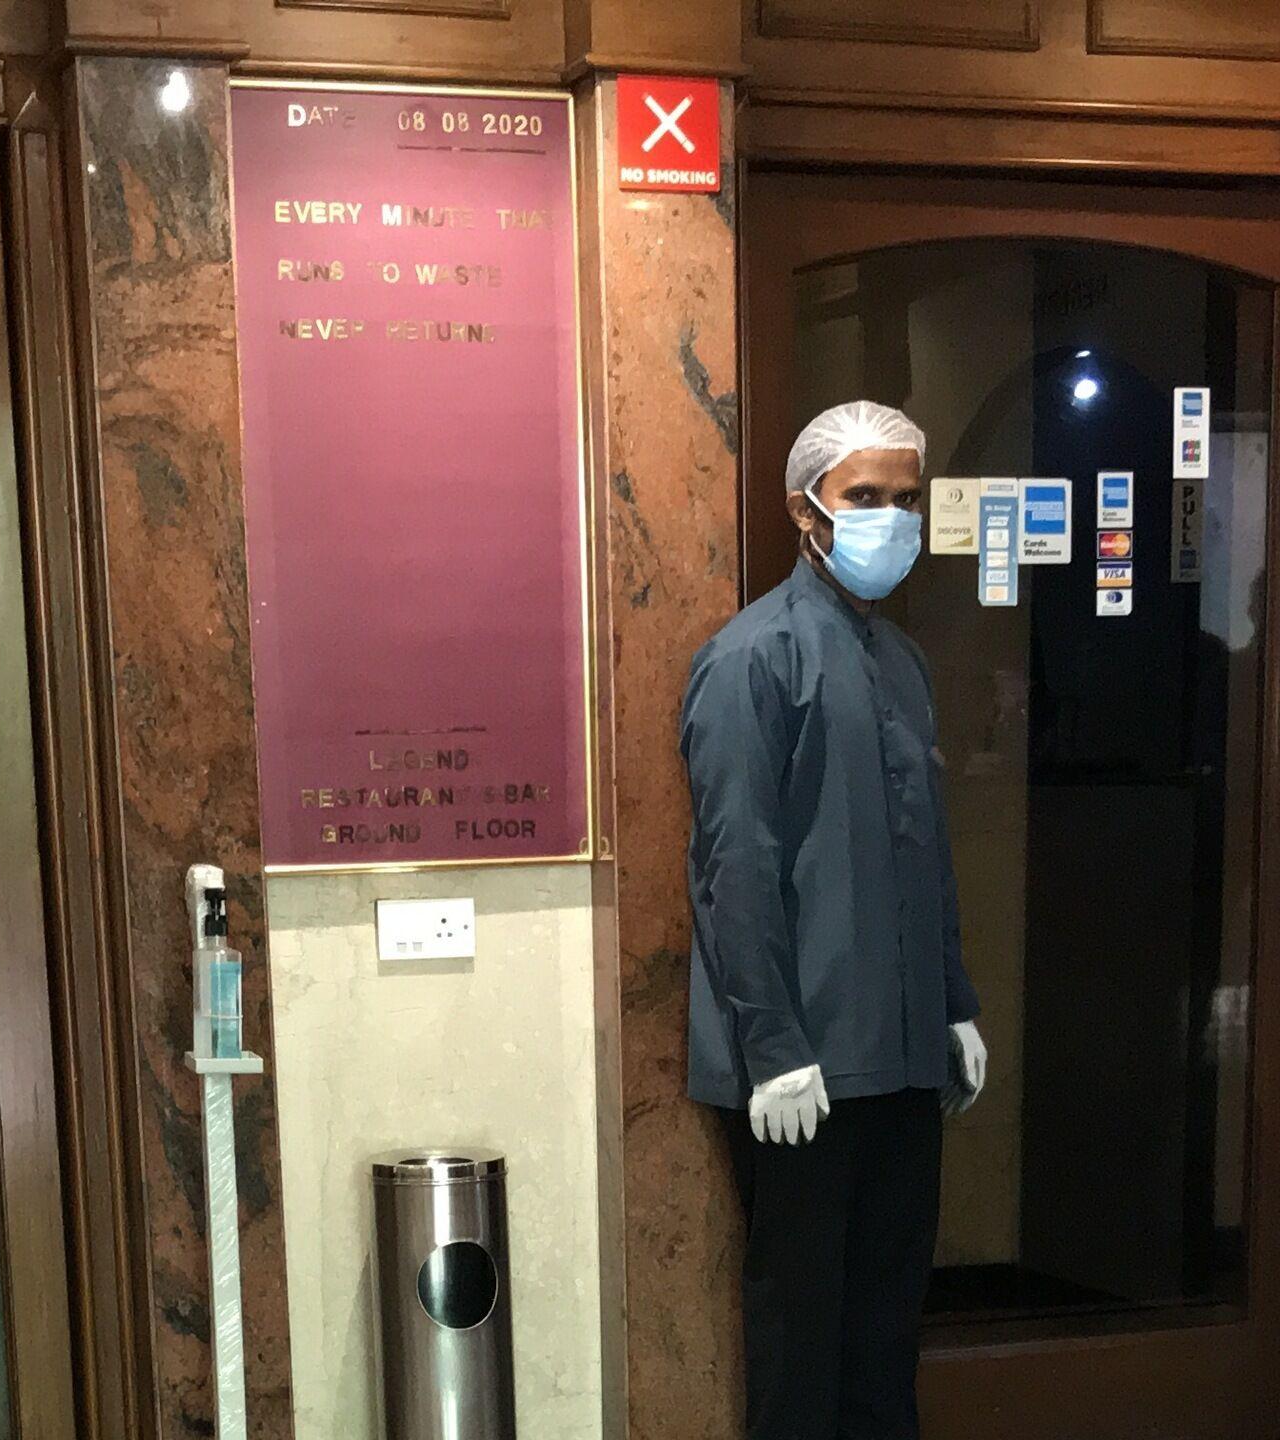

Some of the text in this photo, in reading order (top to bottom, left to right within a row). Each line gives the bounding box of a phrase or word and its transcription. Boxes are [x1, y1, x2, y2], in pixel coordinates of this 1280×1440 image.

[398, 110, 426, 132] 08
[442, 112, 469, 133] 08
[483, 113, 544, 136] 2020
[621, 167, 717, 185] NO SMOKING
[274, 200, 362, 225] EVERY
[495, 208, 554, 231] THA
[277, 259, 345, 282] RUNS
[1024, 540, 1048, 548] Cards
[1024, 549, 1062, 557] Welcome
[1103, 570, 1126, 579] VISA
[300, 785, 471, 809] RESTAURAN
[321, 819, 537, 845] GROUND FLOOR
